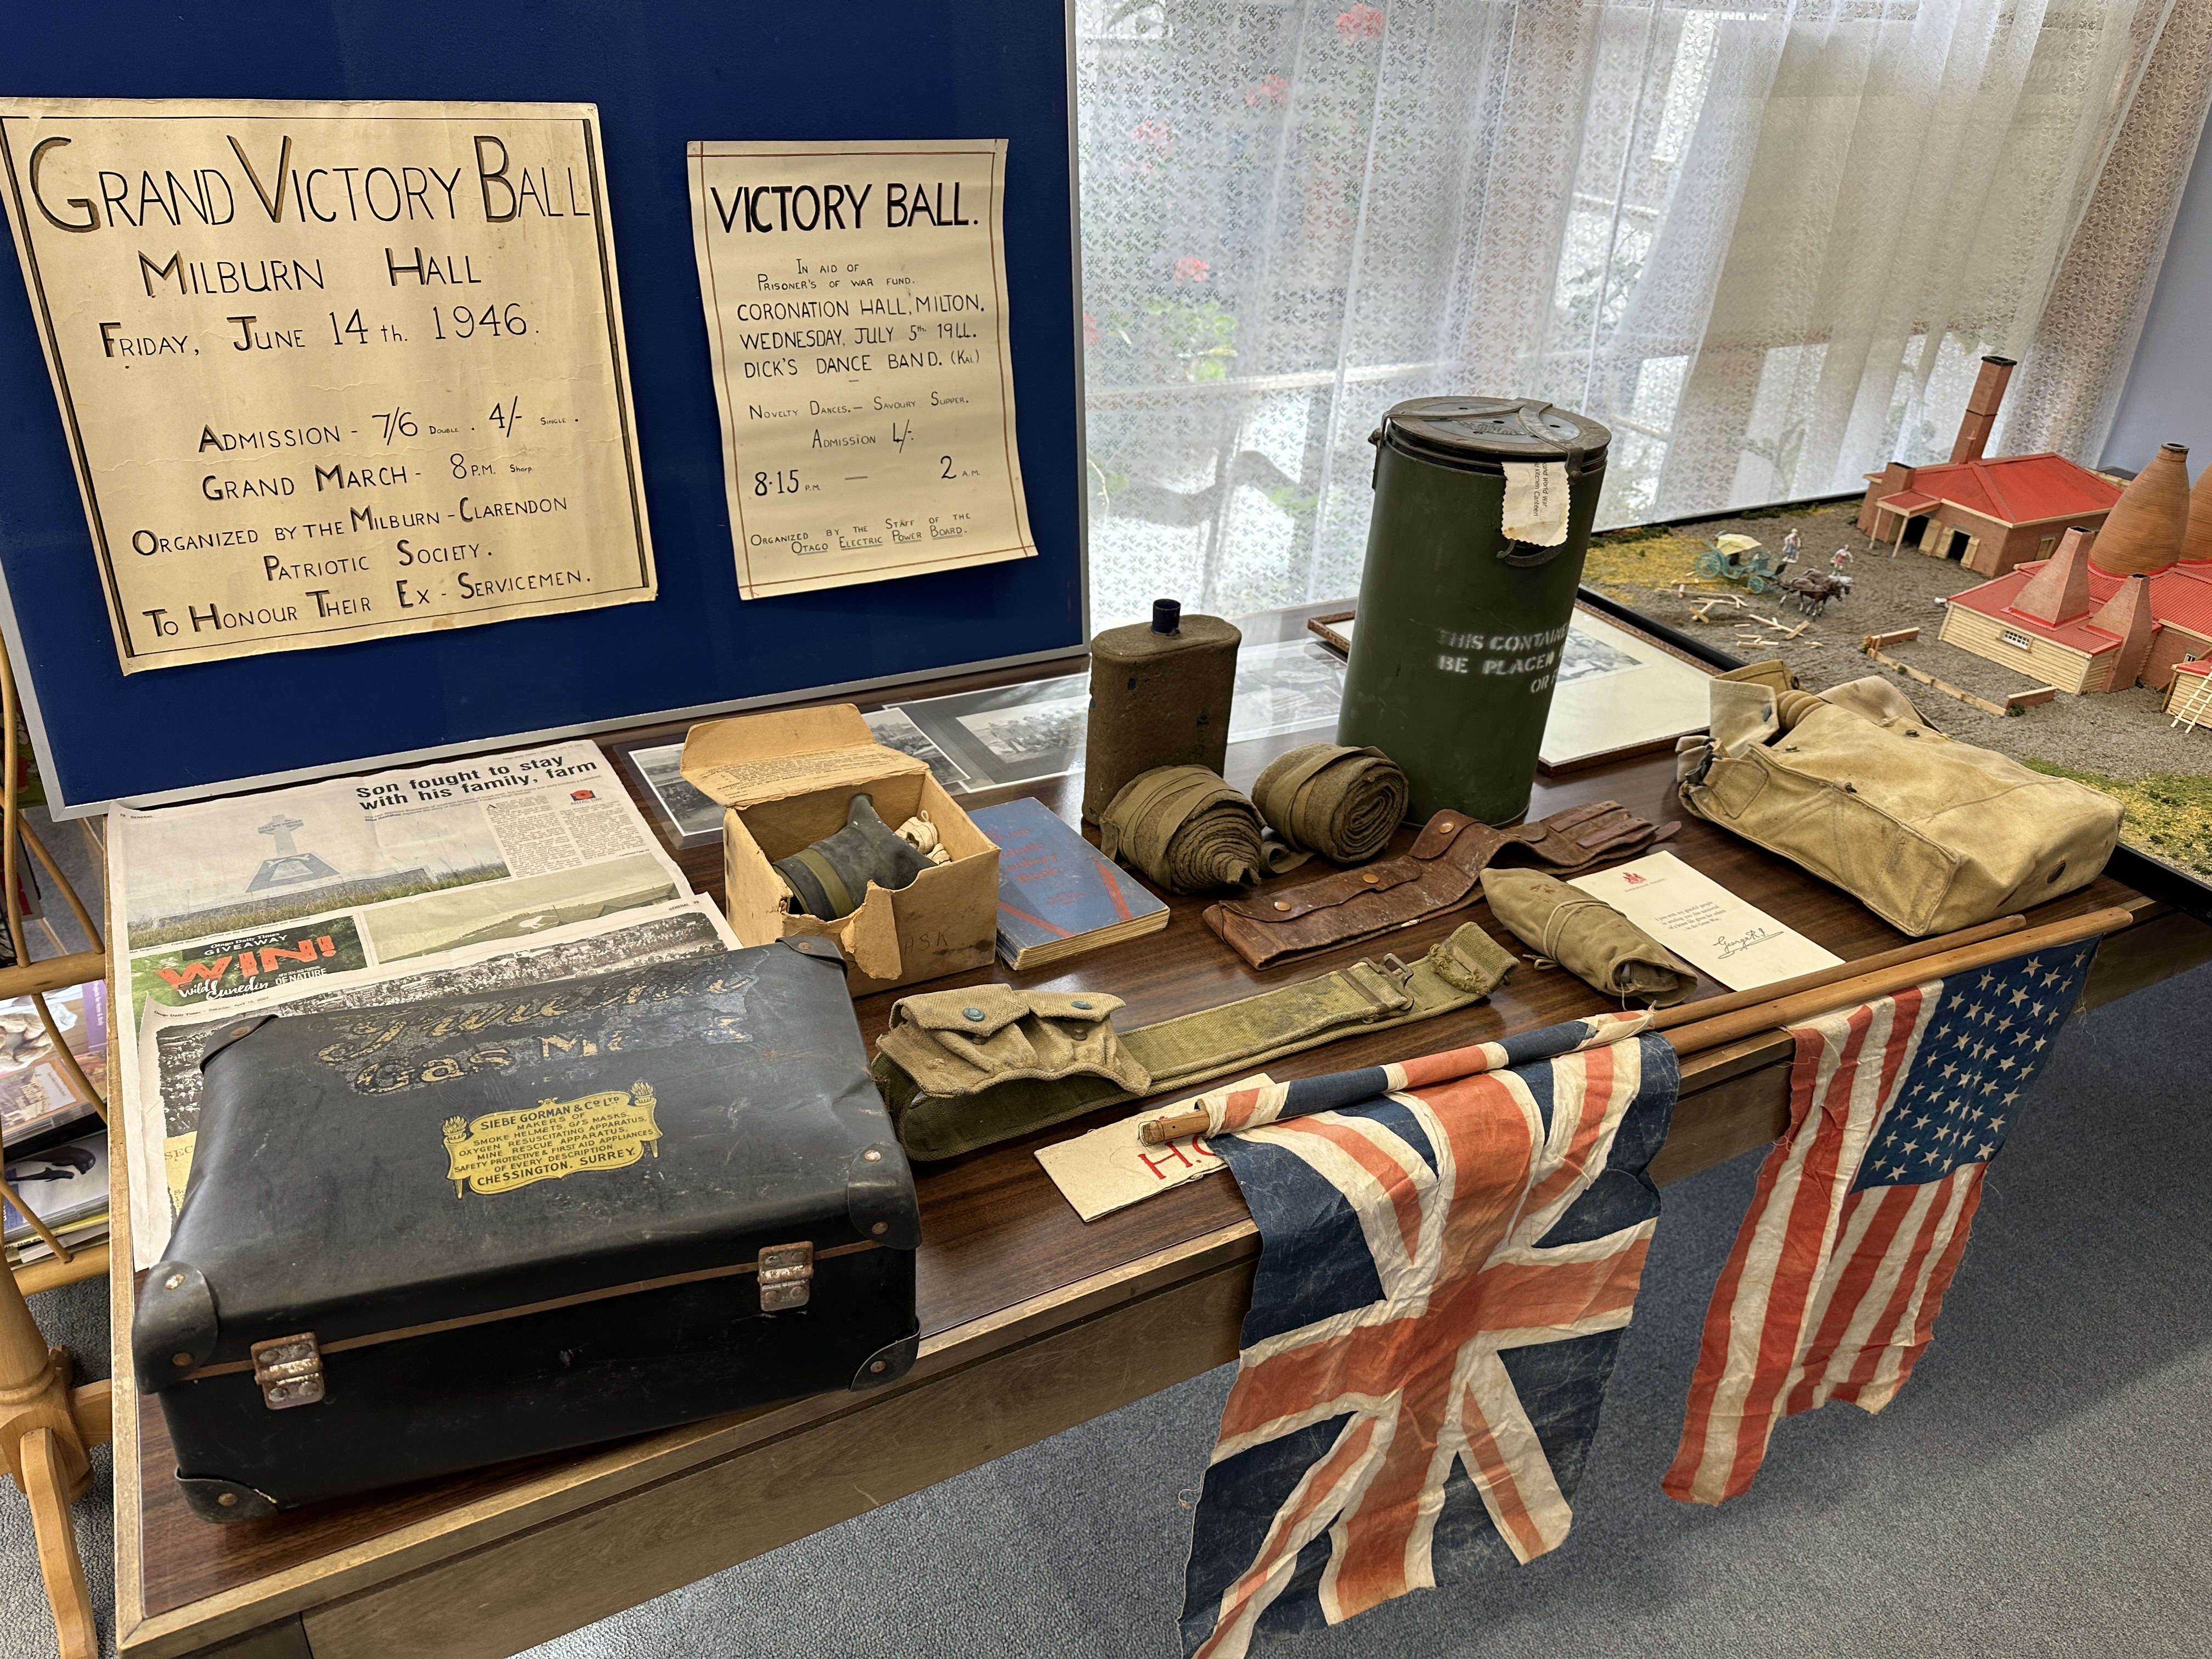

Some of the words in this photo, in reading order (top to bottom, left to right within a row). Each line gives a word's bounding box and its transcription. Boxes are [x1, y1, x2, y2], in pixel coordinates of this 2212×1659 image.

[30, 136, 234, 233] GRAND
[226, 135, 462, 223] VICTORY
[473, 135, 591, 223] BALL
[710, 184, 872, 233] VICTORY
[887, 182, 978, 227] BALL.
[138, 249, 325, 298] MILBURN
[385, 247, 481, 287] HALL
[820, 264, 838, 273] AID
[847, 264, 860, 272] OF
[758, 274, 817, 291] PRISONER'S
[829, 279, 839, 287] OF
[851, 278, 873, 286] WAR
[886, 276, 915, 285] FUND.
[737, 300, 849, 320] CORONATION
[861, 297, 912, 315] HALL,
[915, 295, 984, 313] MILTON.
[99, 322, 200, 358] FRIDAY,
[226, 315, 306, 352] JUNE
[328, 309, 369, 345] 14
[433, 303, 539, 341] 1946.
[739, 330, 845, 349] WEDNESDAY,
[854, 327, 894, 344] JULY
[744, 359, 798, 377] DICK'S
[816, 355, 871, 374] DANCE
[888, 352, 943, 369] BAND.
[749, 405, 798, 420] NOVELTY
[873, 397, 916, 411] SAVOURY
[198, 425, 340, 453] ADMISSION
[371, 407, 418, 445] 7/6
[489, 396, 522, 438] 4/-
[812, 429, 876, 449] ADMISSION
[202, 475, 295, 501] GRAND
[315, 464, 407, 492] MARCH
[449, 453, 467, 479] 8
[471, 465, 495, 477] P.M.
[940, 456, 956, 479] 2
[132, 529, 258, 556] ORGANIZED
[275, 524, 297, 540] BY
[302, 520, 343, 537] THE
[751, 532, 809, 546] ORGANIZED
[826, 528, 839, 537] BY
[885, 518, 915, 529] STAFF
[792, 541, 828, 554] OTAGO
[839, 535, 883, 549] ELECTRIC
[892, 530, 922, 543] POWER
[930, 524, 967, 538] BOARD.
[263, 554, 369, 582] PATRIOTIC
[142, 607, 178, 637] TO
[190, 603, 297, 631] HONOUR
[305, 589, 371, 619] THEIR
[396, 579, 430, 608] EX
[1489, 622, 1568, 651] CONTAINE
[1438, 654, 1469, 674] BE
[1531, 675, 1549, 693] OR
[356, 782, 399, 798] Son
[409, 770, 481, 791] fought
[488, 765, 510, 777] to
[520, 755, 563, 770] stay
[359, 794, 408, 811] with
[418, 789, 452, 802] his
[461, 775, 538, 793] family,
[546, 760, 597, 779] farm
[204, 935, 288, 956] GIVEAWAY
[210, 939, 234, 949] Otago
[235, 935, 256, 945] Daily
[257, 932, 280, 941] Times
[156, 935, 336, 990] WIN!
[177, 979, 211, 997] Wild
[275, 977, 288, 985] OF
[289, 968, 326, 982] NATURE
[481, 1116, 517, 1130] SIEBE
[520, 1106, 571, 1123] GORMAN
[574, 1104, 583, 1113] &
[517, 1116, 565, 1130] MAKERS
[459, 1143, 500, 1156] OXYGEN
[508, 1127, 584, 1147] RESUSCITATING
[473, 1135, 509, 1146] SMOKE
[569, 1119, 590, 1127] GAS
[454, 1161, 488, 1173] SAFETY
[490, 1150, 540, 1165] PROTECTIVE
[552, 1144, 576, 1154] FIRST
[578, 1140, 595, 1149] AID
[600, 1129, 654, 1144] APPLIANCES
[477, 1150, 504, 1160] MINE
[512, 1141, 552, 1153] RESCUE
[511, 1158, 543, 1170] EVERY
[549, 1144, 613, 1162] DESCRIPTION
